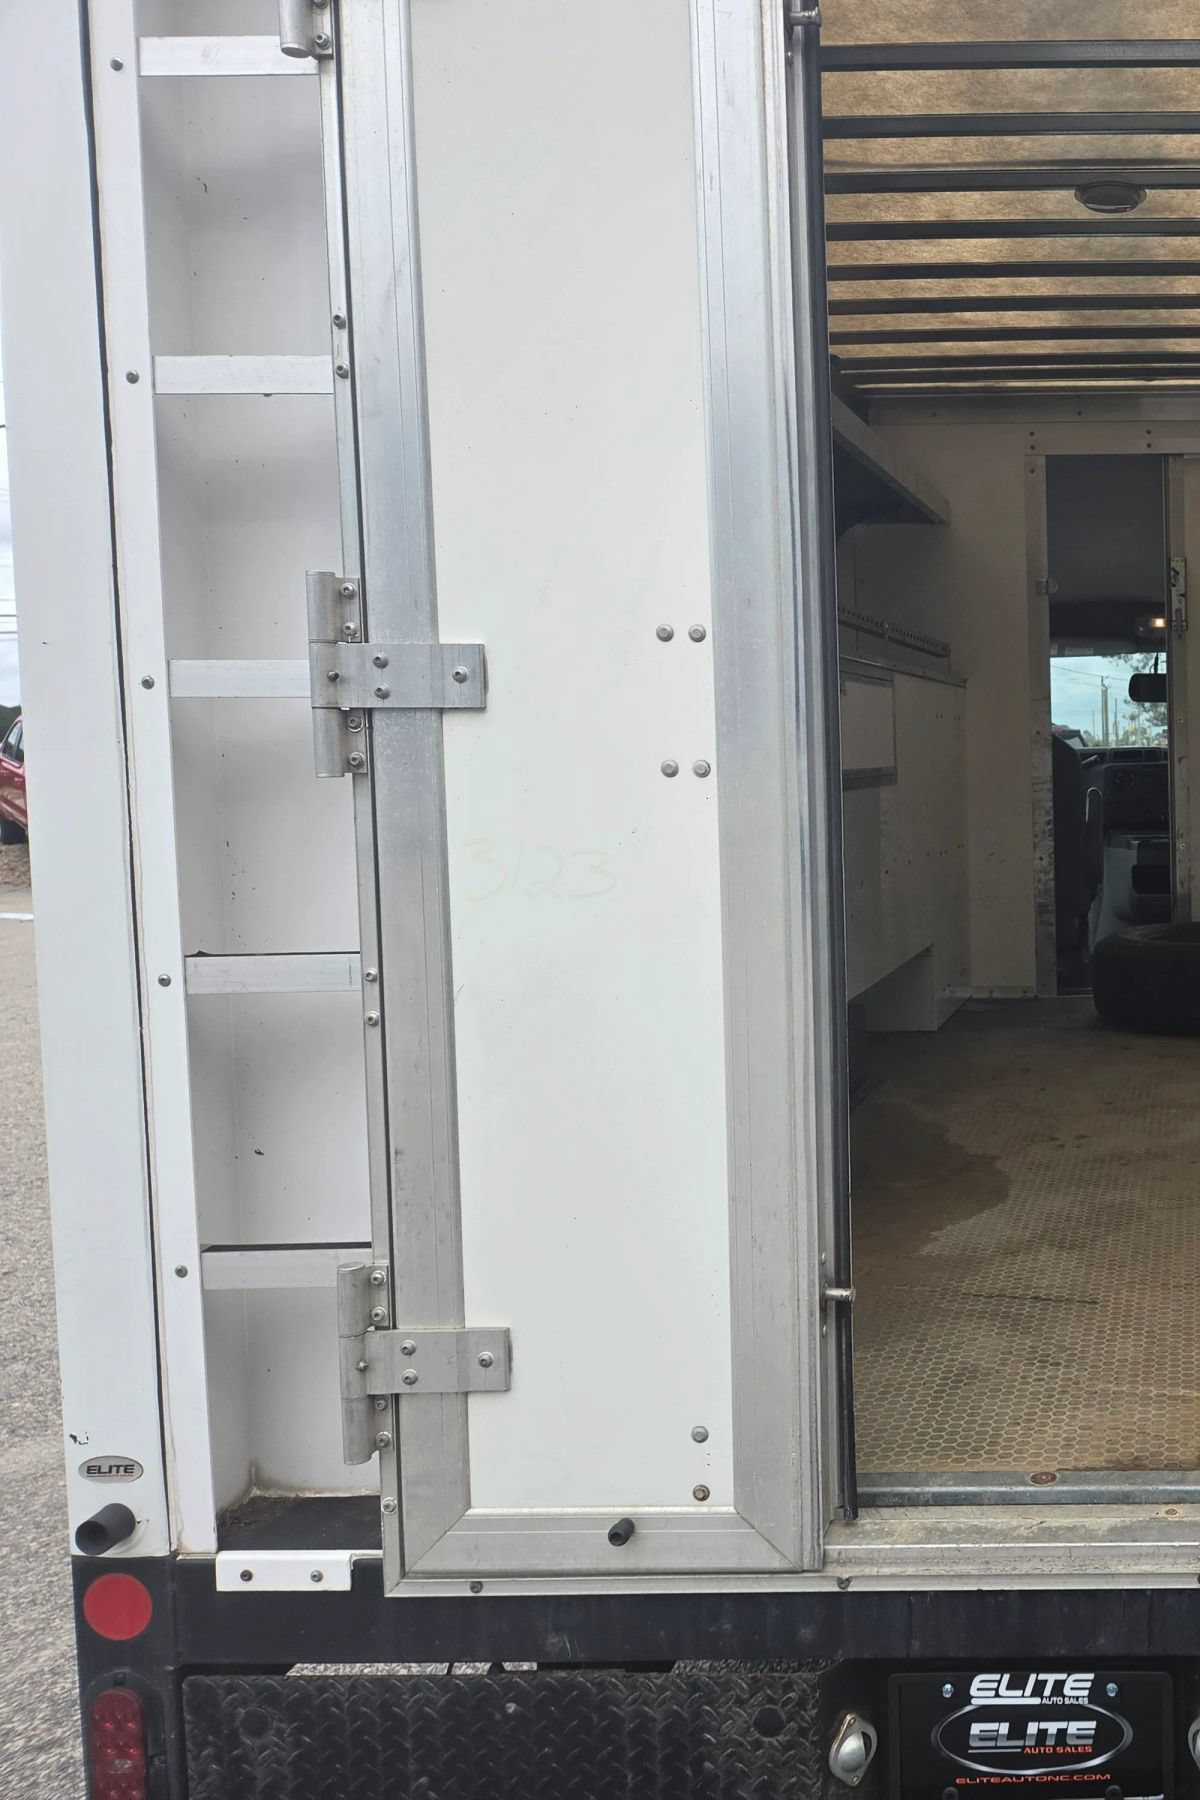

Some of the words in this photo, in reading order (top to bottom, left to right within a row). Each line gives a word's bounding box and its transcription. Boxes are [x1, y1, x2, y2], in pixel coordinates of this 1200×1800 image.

[86, 1464, 135, 1474] ELITE
[970, 1673, 1094, 1697] ELITE
[969, 1721, 1097, 1746] ELITE
[1024, 1746, 1053, 1754] AUTO
[1056, 1745, 1093, 1754] SALES
[955, 1774, 1111, 1784] ELITEAUTONC.COM
